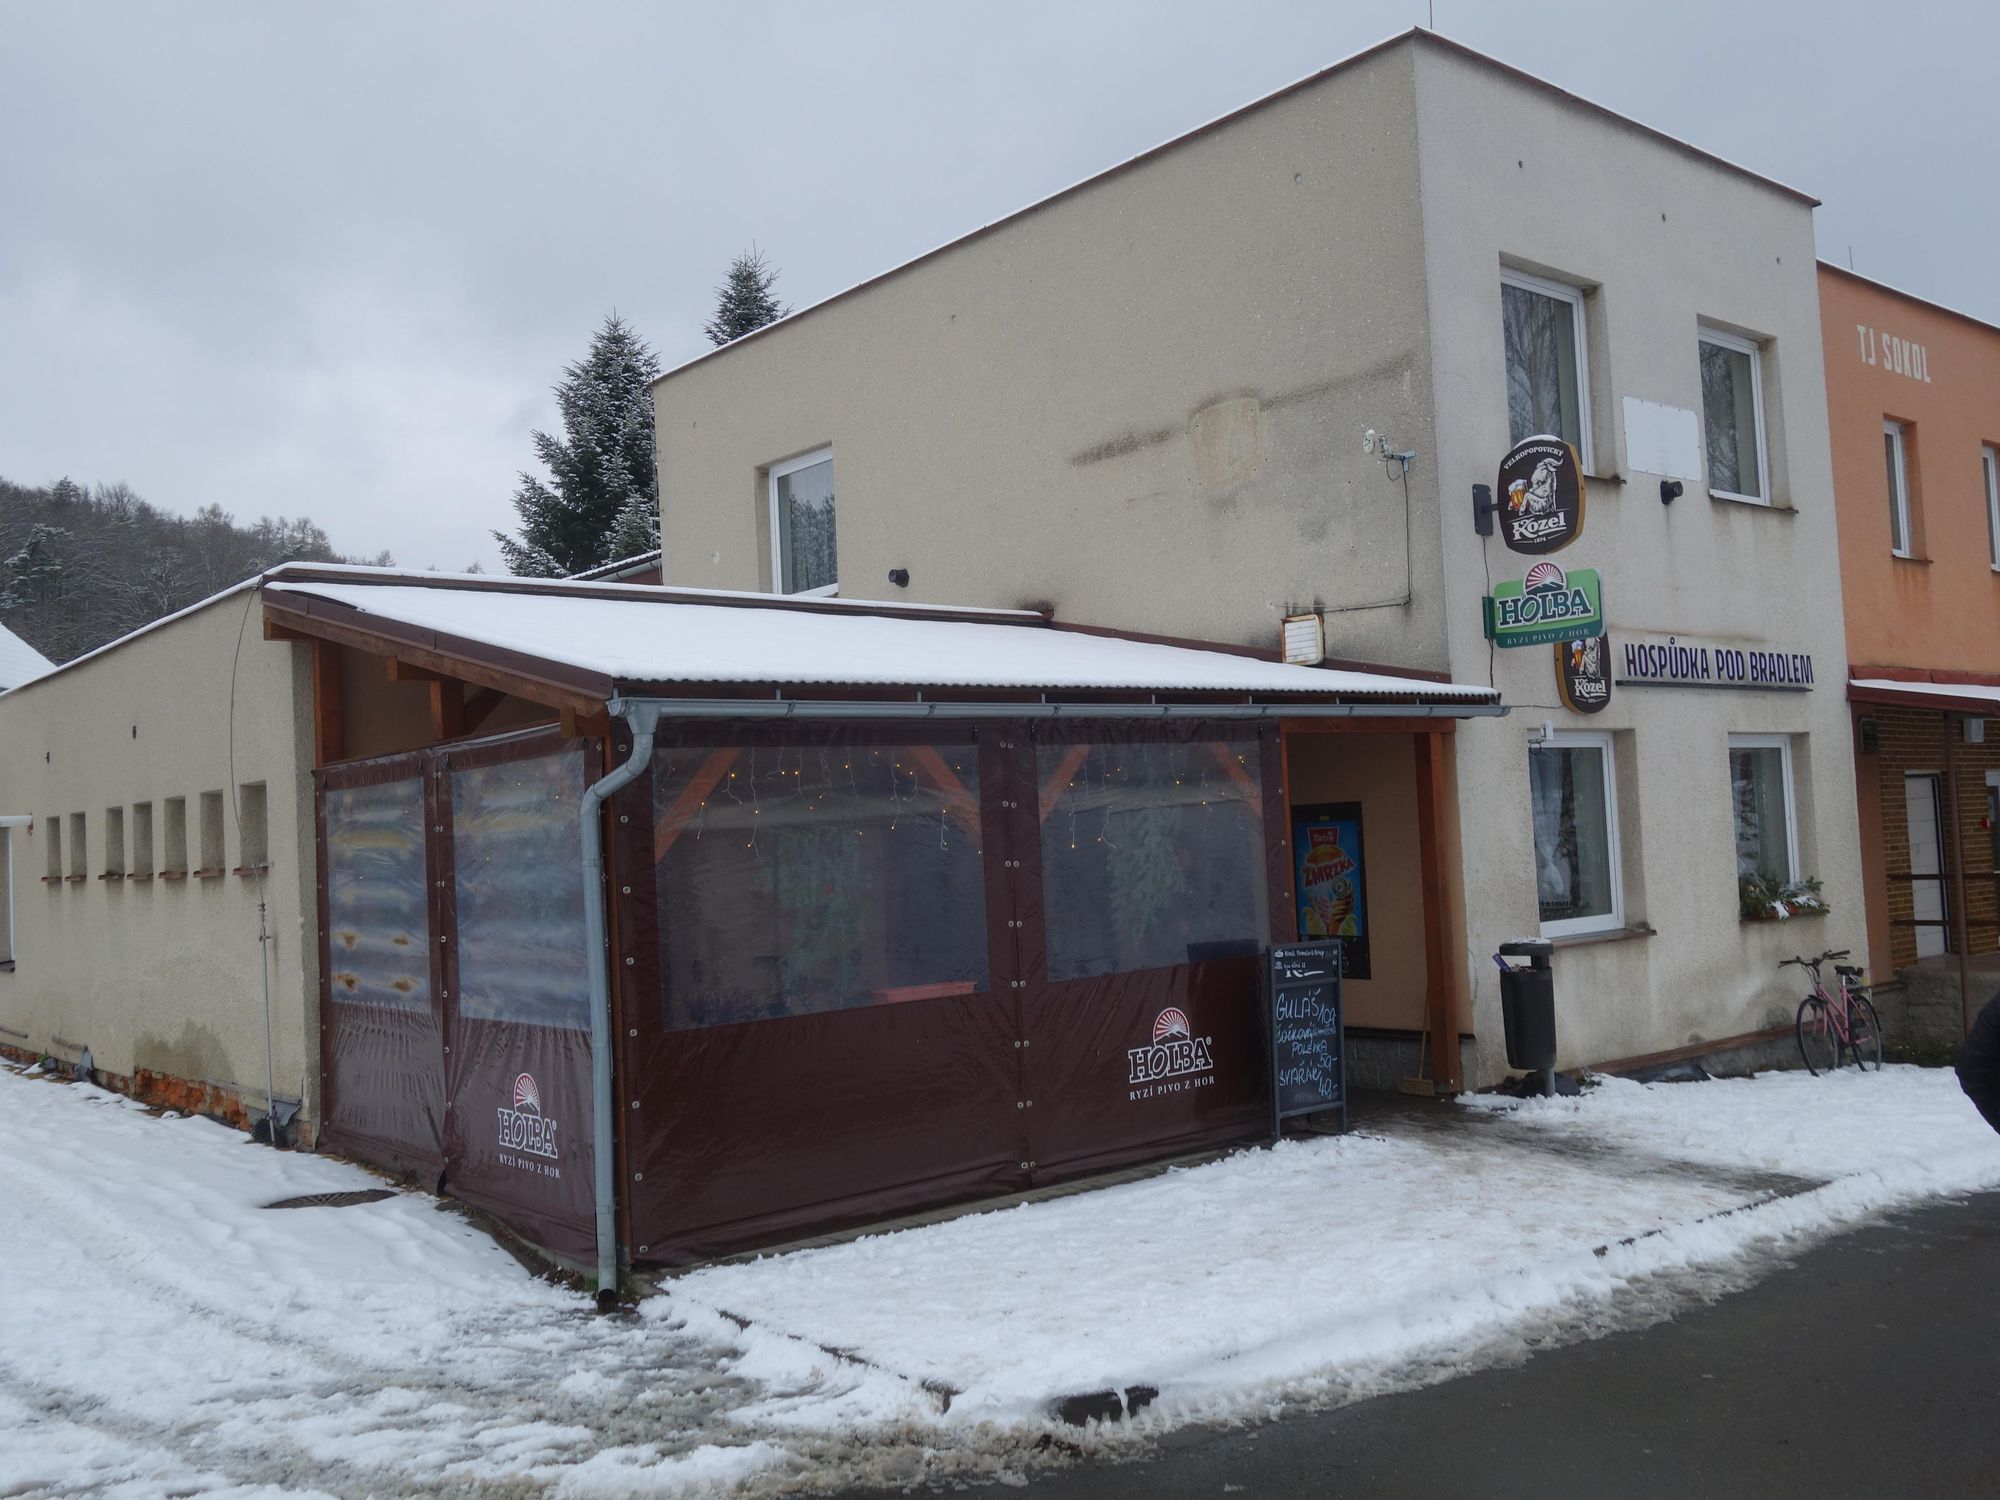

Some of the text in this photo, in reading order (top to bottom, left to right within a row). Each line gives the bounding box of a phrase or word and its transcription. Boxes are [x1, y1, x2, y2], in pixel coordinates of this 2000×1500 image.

[1857, 324, 1931, 384] TJ SOKOL
[1503, 446, 1564, 470] VELKOPOPOVICKÝ
[1512, 512, 1567, 540] Kozel
[1499, 588, 1592, 627] HOLBA
[1533, 633, 1555, 642] PIVO
[1569, 628, 1589, 637] HOR
[1624, 637, 1815, 684] HOSPŮDKA POD BRADLEM
[1574, 678, 1608, 697] Kozel
[1276, 988, 1321, 1021] GULÁŠ
[1128, 1037, 1213, 1084] HOLBA
[1130, 1075, 1215, 1100] RYZÍ PIVO Z HOR
[498, 1107, 558, 1159] HOLBA
[499, 1153, 560, 1179] RYZÍ PIVO Z HOR
